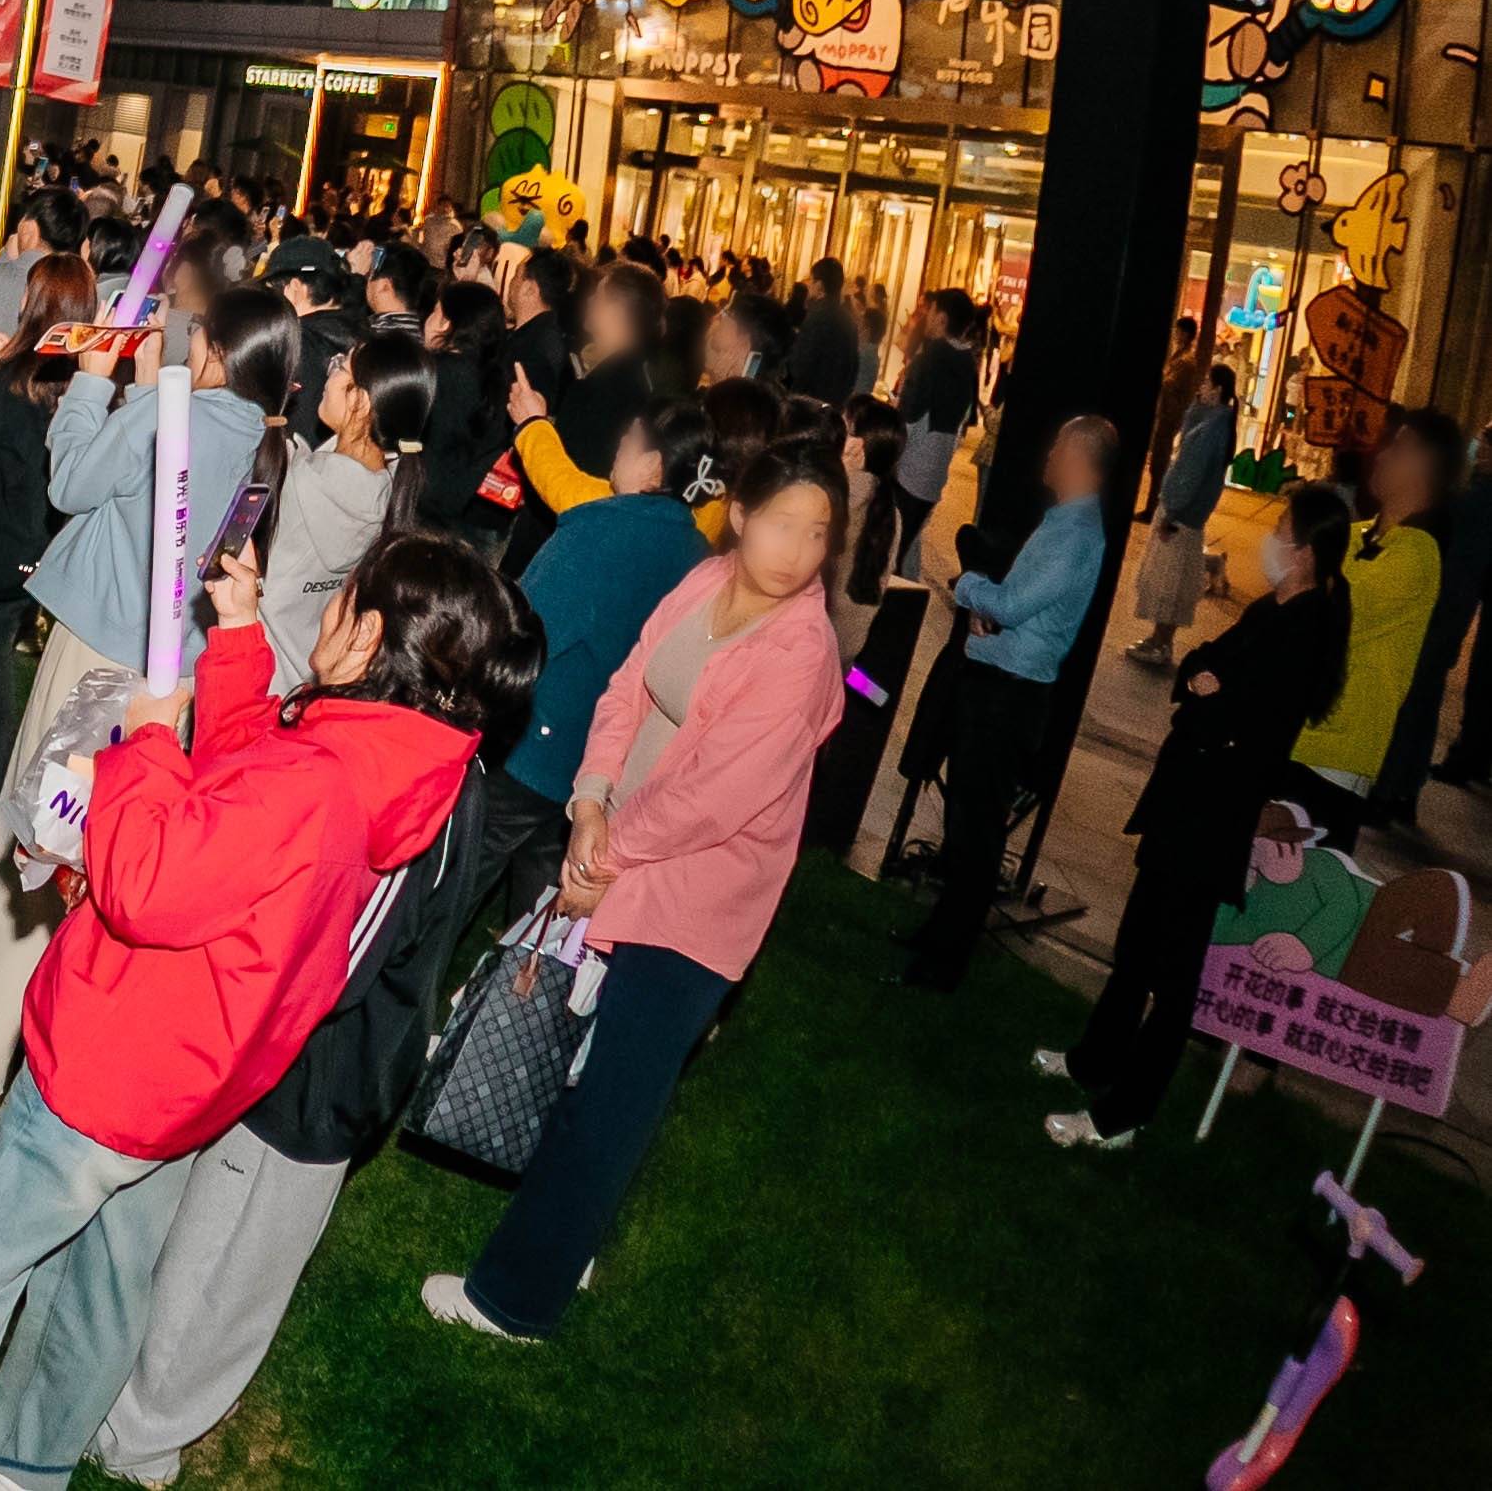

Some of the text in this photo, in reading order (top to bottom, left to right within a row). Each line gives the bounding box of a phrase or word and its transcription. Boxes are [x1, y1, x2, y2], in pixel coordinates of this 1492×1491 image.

[820, 42, 888, 63] MOPPSY
[245, 65, 379, 95] STARBUCKS COFFEE
[49, 789, 88, 836] NI
[1223, 962, 1308, 1011] 开花的事
